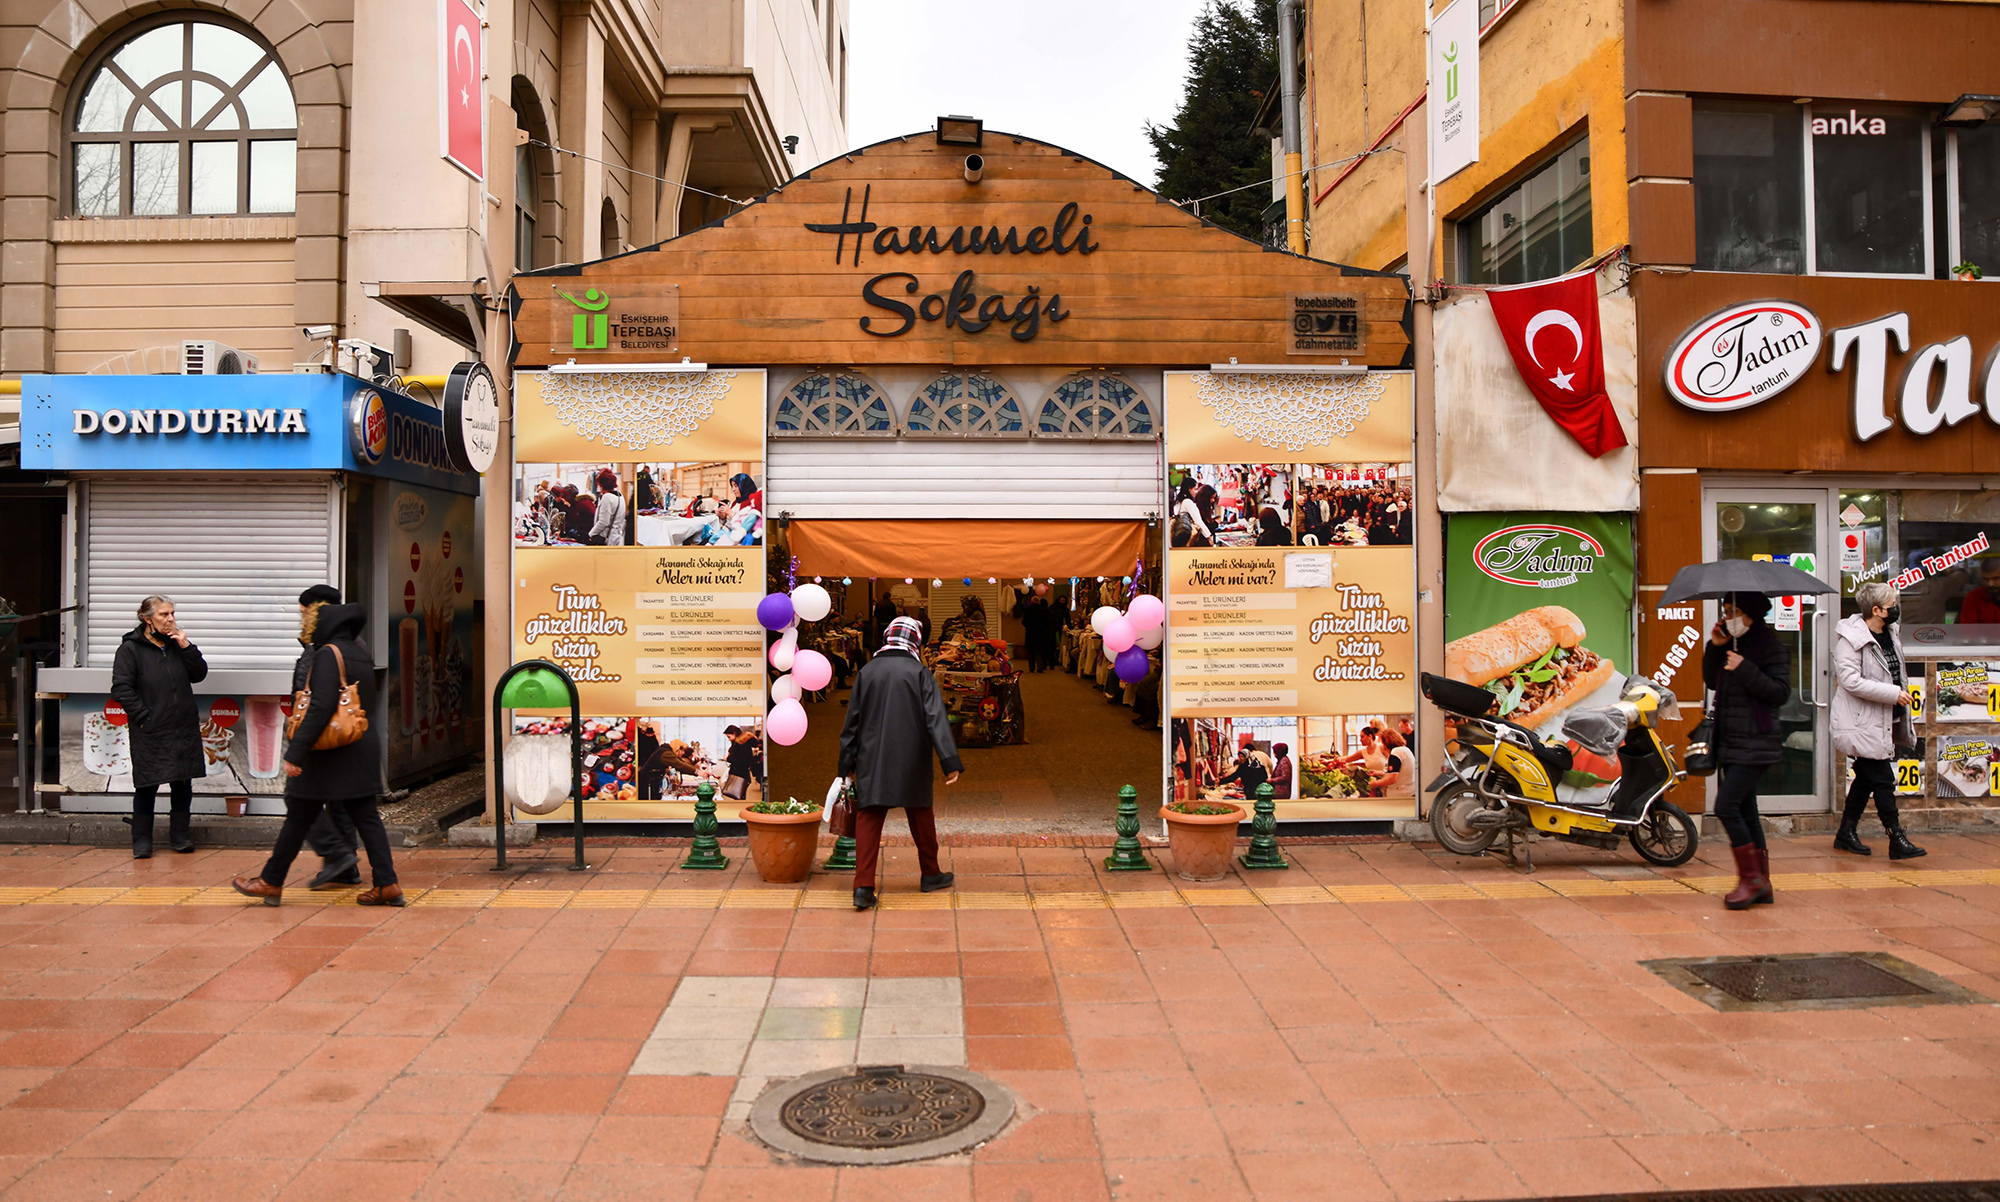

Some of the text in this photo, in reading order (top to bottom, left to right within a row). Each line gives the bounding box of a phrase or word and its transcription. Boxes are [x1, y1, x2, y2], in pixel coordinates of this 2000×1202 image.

[804, 184, 1099, 267] Hanımeli
[859, 269, 1070, 341] Sokağı
[621, 314, 669, 325] ESKİŞEHİR
[611, 324, 676, 339] TEPEBAŞI
[621, 340, 669, 349] BELEDİYESİ
[1295, 338, 1358, 350] dtahmetatac
[1697, 314, 1809, 396] Tadım
[1826, 310, 2000, 443] Ta
[72, 408, 309, 435] DONDURMA
[392, 412, 466, 476] DONDUR
[656, 557, 744, 571] Hanımeli Sokağı'nda
[1484, 533, 1594, 574] Tadım
[1887, 531, 1990, 592] rsin Tantuni
[1188, 558, 1275, 572] Hanımeli Sokağı'nda
[656, 569, 745, 585] Neler mi var?
[1188, 570, 1276, 586] Neler mi var?
[552, 584, 600, 611] Tüm
[680, 594, 714, 602] ÜRÜNLERİ
[1213, 595, 1246, 603] ÜRÜNLERİ
[1336, 584, 1383, 610] Tüm
[680, 610, 714, 618] ÜRÜNLERİ
[1213, 611, 1246, 619] ÜRÜNLERİ
[1658, 607, 1695, 620] PAKET
[526, 610, 626, 643] güzellikler
[1310, 610, 1408, 643] güzellikler
[554, 638, 599, 658] sizin
[1338, 637, 1382, 656] sizin
[1666, 644, 1688, 668] 66
[1678, 625, 1700, 650] 20
[561, 659, 620, 681] izde...
[1315, 656, 1404, 681] elinizde...
[1940, 668, 1964, 679] Ekmek
[1939, 679, 1960, 687] Tavuk
[1911, 690, 1921, 711] 6
[1989, 688, 1998, 712] 1
[1942, 752, 1964, 761] Tavuk
[1898, 765, 1919, 786] 26
[1991, 766, 1999, 790] 1
